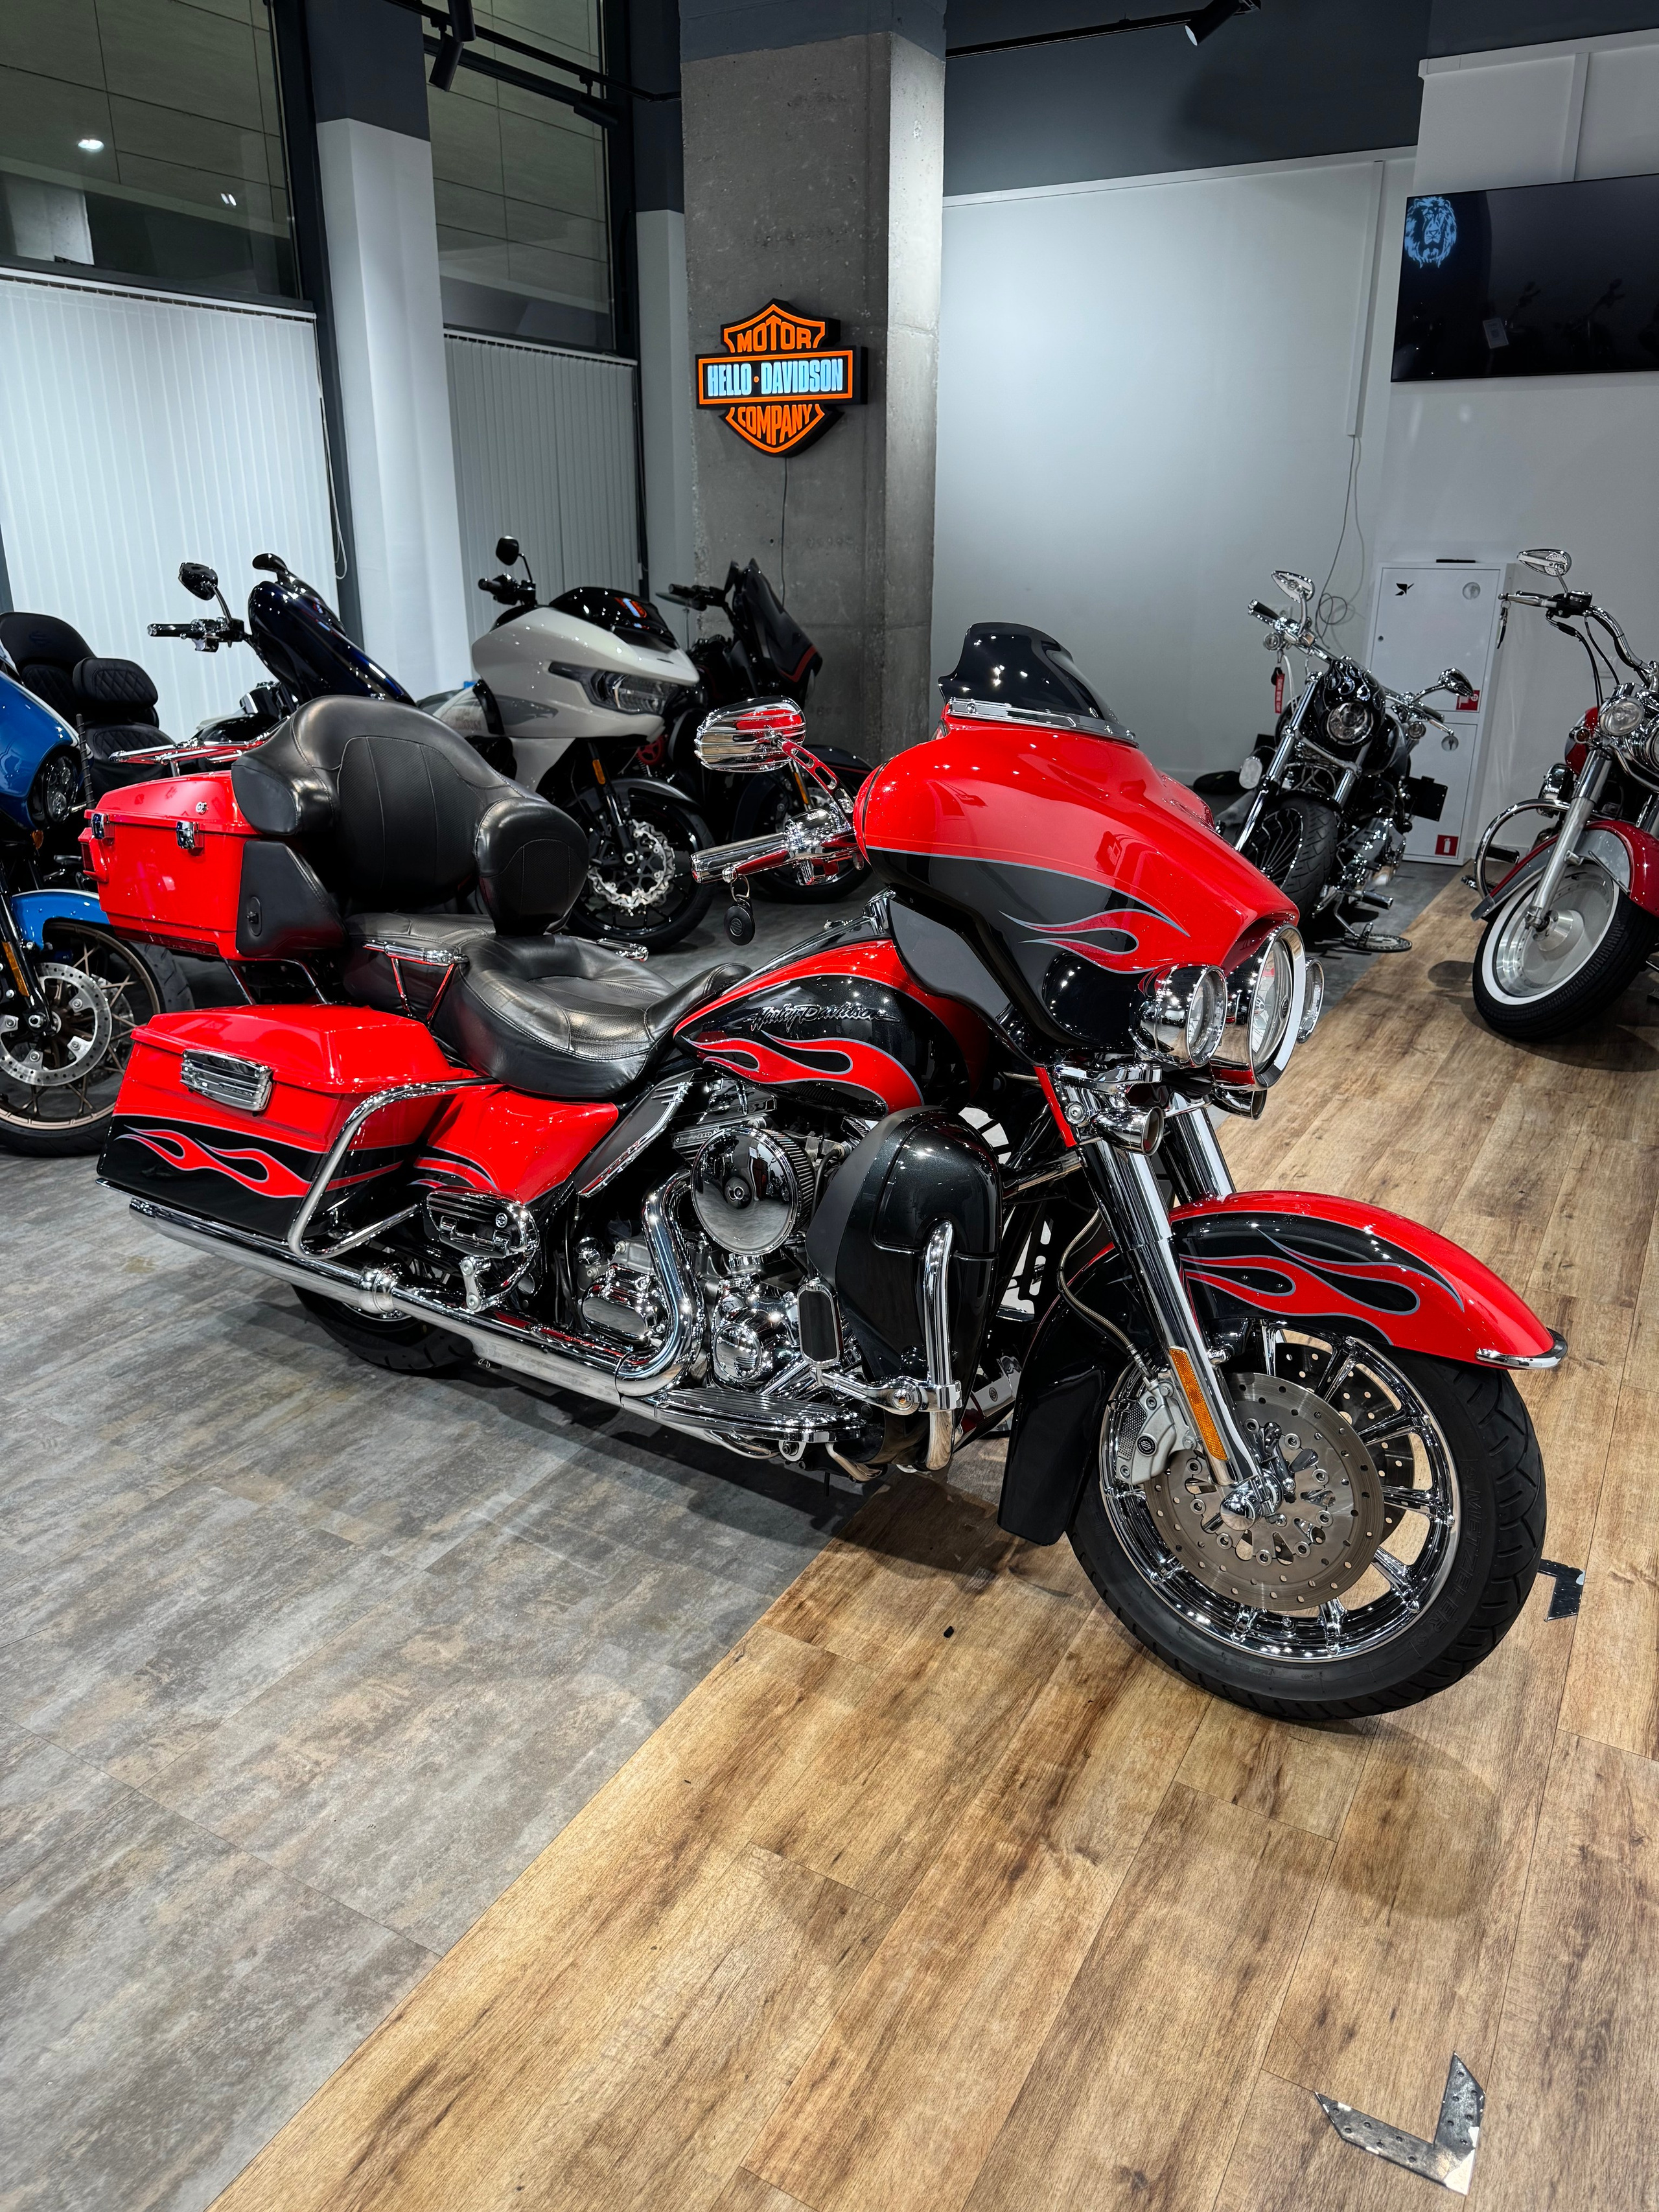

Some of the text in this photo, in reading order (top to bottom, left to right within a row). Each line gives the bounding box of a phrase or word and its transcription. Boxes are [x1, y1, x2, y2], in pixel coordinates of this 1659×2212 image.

[737, 314, 811, 353] MOTOR
[707, 358, 843, 397] HELLO DAVIDSON
[737, 404, 813, 445] COMPANY
[1428, 1489, 1483, 1633] METZELER
